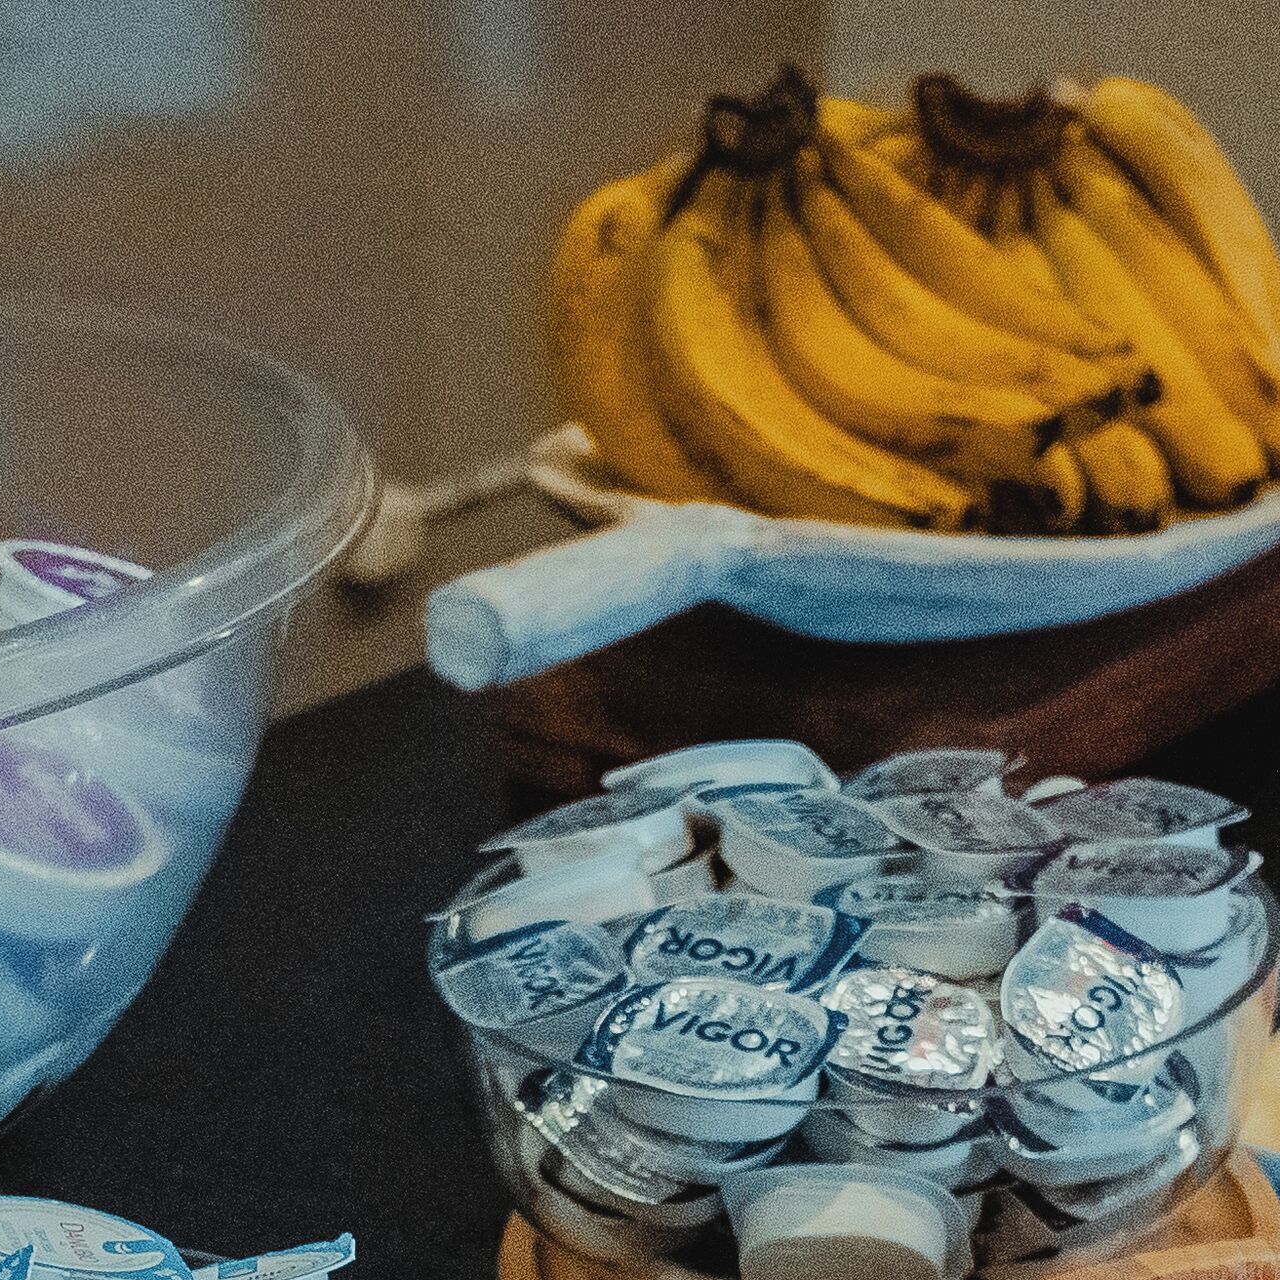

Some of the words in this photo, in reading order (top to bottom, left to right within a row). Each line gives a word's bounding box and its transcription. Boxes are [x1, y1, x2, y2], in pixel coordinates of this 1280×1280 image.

[658, 925, 799, 981] VIGOR
[646, 1006, 801, 1068] VIGOR
[861, 983, 932, 1073] VIGOR
